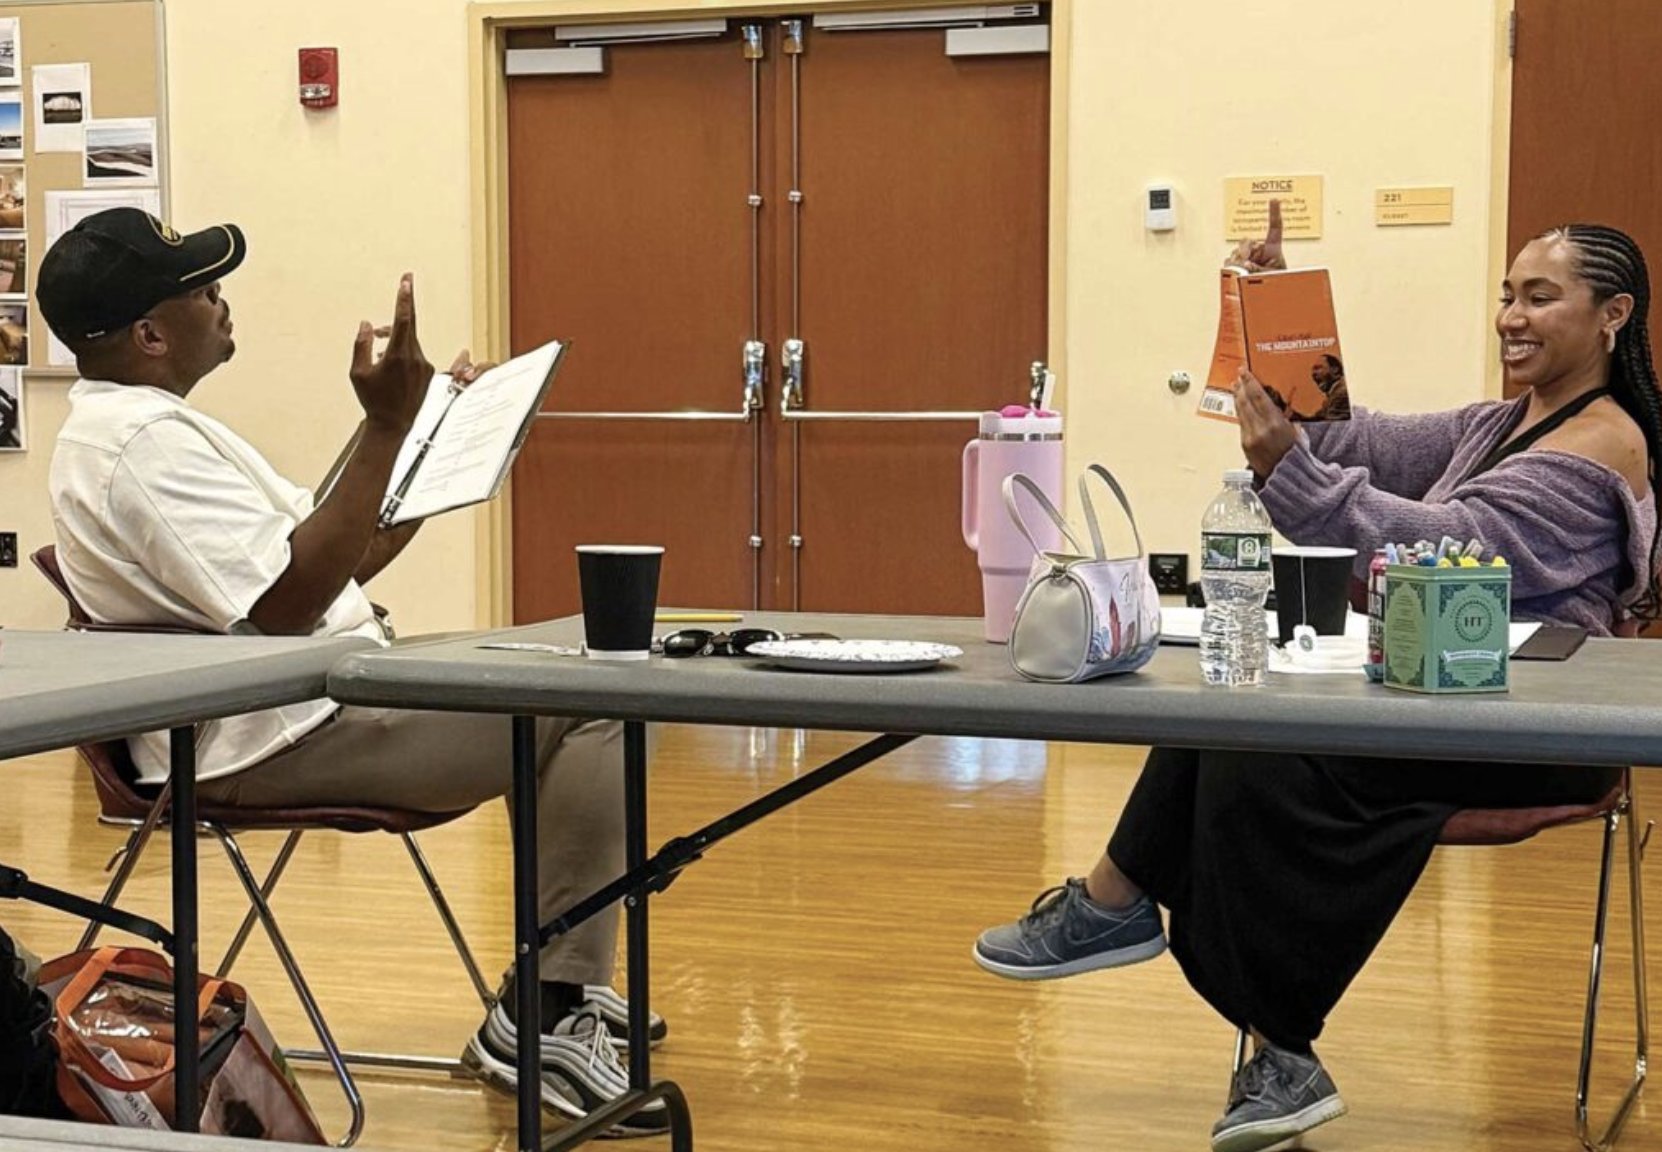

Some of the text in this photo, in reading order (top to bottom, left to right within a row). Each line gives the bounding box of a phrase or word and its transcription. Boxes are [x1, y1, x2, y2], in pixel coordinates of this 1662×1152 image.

[1251, 180, 1292, 190] NOTICE
[1384, 193, 1401, 203] 221
[1255, 341, 1273, 353] THE
[1273, 336, 1336, 351] MOUNTAINTOP
